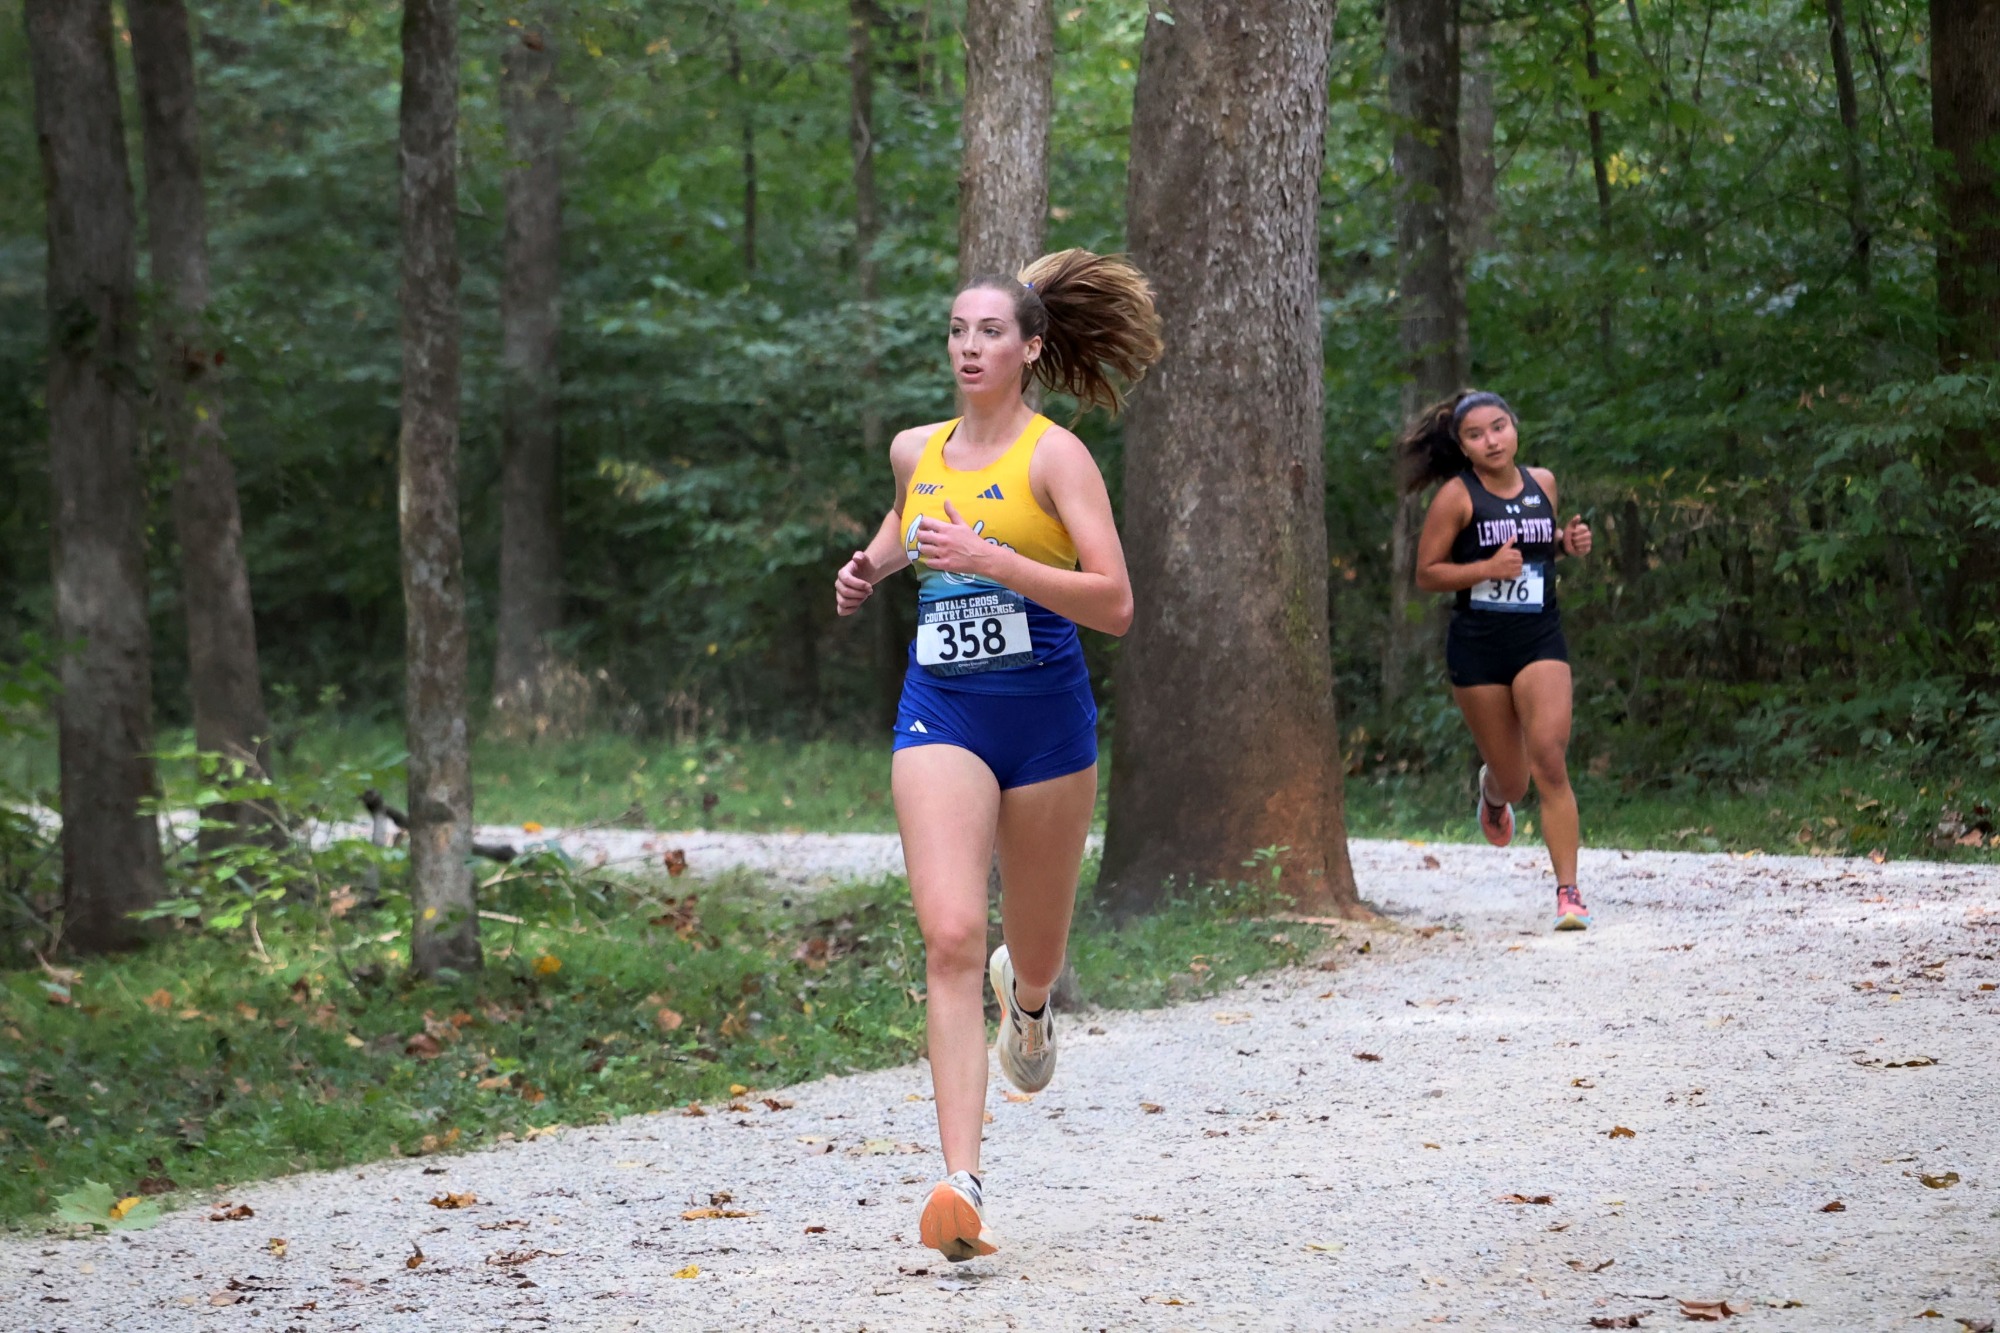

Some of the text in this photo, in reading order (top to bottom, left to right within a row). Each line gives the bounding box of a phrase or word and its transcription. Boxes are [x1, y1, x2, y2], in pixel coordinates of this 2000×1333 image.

[1488, 580, 1529, 602] 376
[924, 603, 1016, 624] COUNTRY CHALLENGE
[935, 594, 999, 612] ROYALS CROSS
[936, 617, 1006, 662] 358
